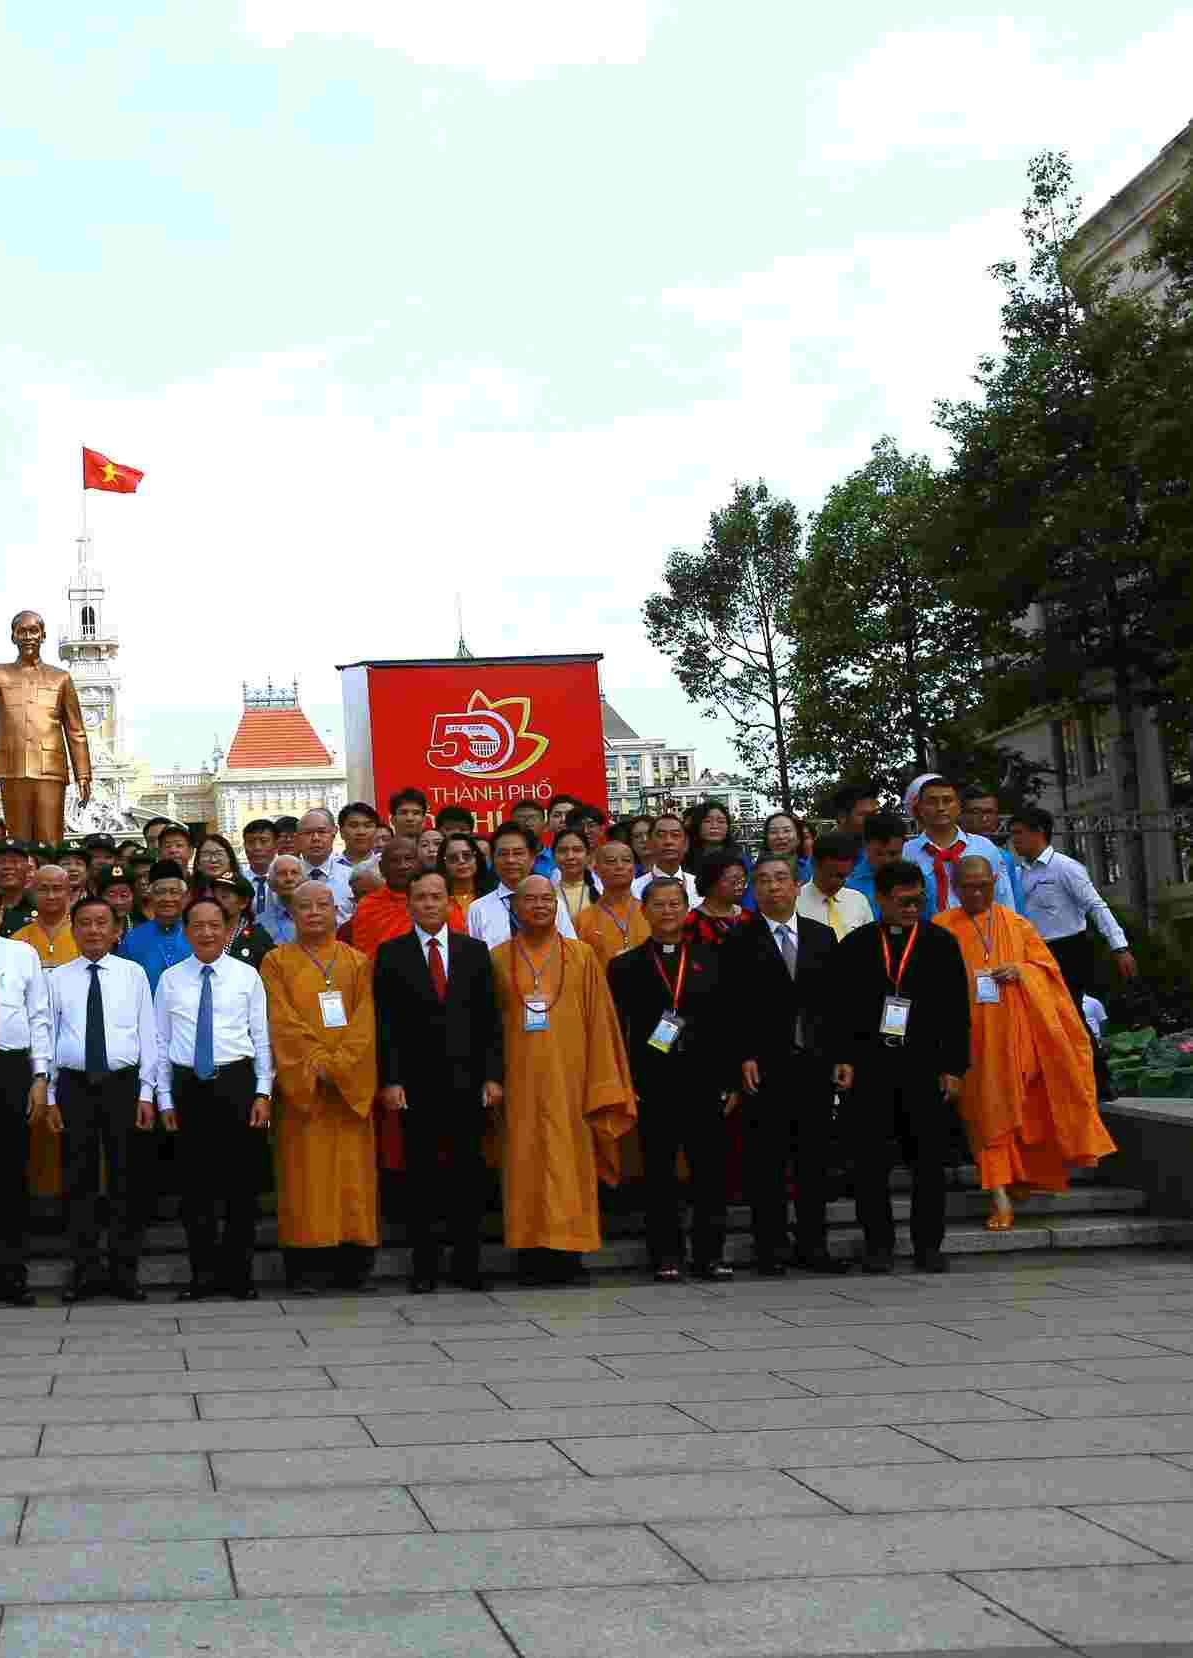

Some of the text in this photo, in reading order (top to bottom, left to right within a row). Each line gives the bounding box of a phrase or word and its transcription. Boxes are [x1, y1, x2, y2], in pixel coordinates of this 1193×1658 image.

[427, 709, 514, 774] 50
[429, 777, 553, 804] THÀNH PHỐ
